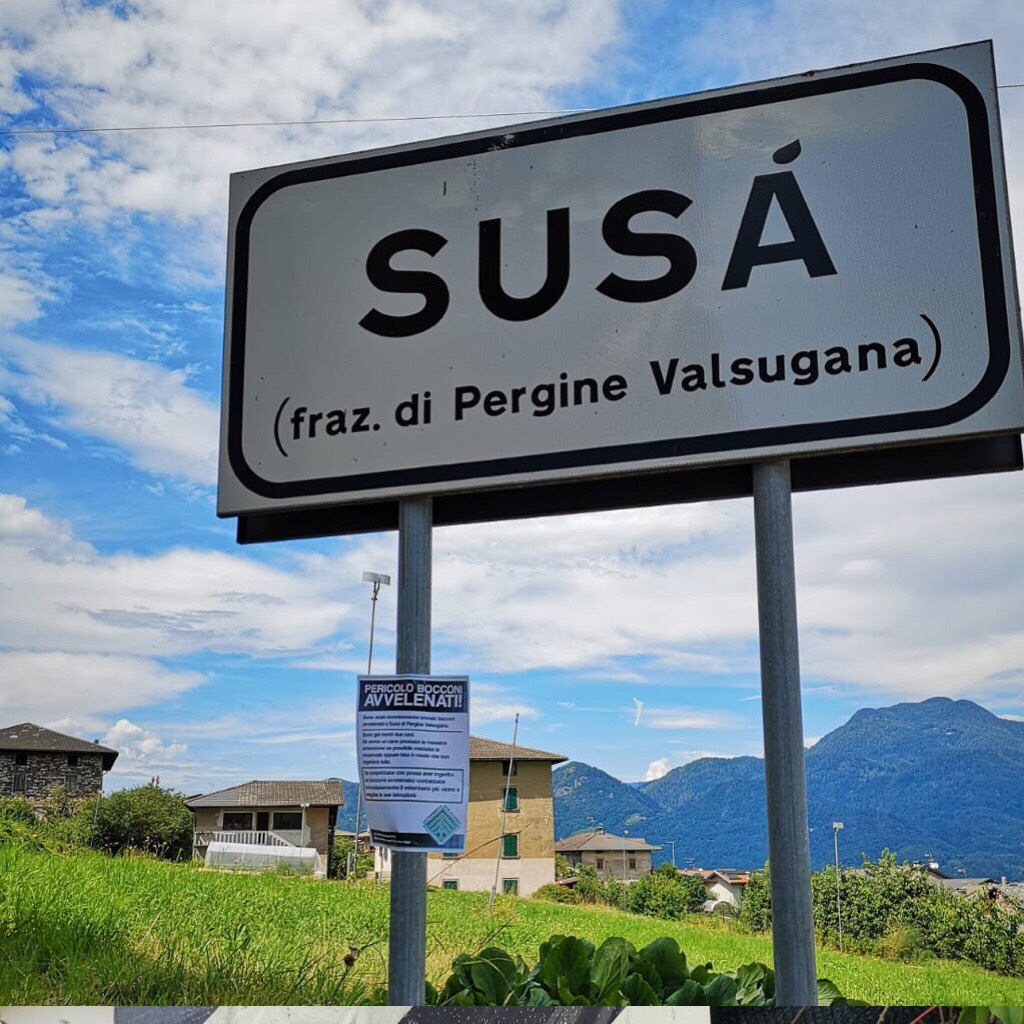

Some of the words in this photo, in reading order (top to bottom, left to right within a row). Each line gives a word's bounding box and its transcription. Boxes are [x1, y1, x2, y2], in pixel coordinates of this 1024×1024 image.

[358, 138, 838, 338] SUSÁ
[273, 396, 381, 457] (fraz.
[394, 391, 432, 427] di
[454, 372, 628, 421] Pergine
[649, 314, 942, 396] Valsugana)
[364, 693, 462, 708] AVVELENATI!
[365, 683, 414, 693] PERICOLO
[417, 684, 463, 694] BOCCONI
